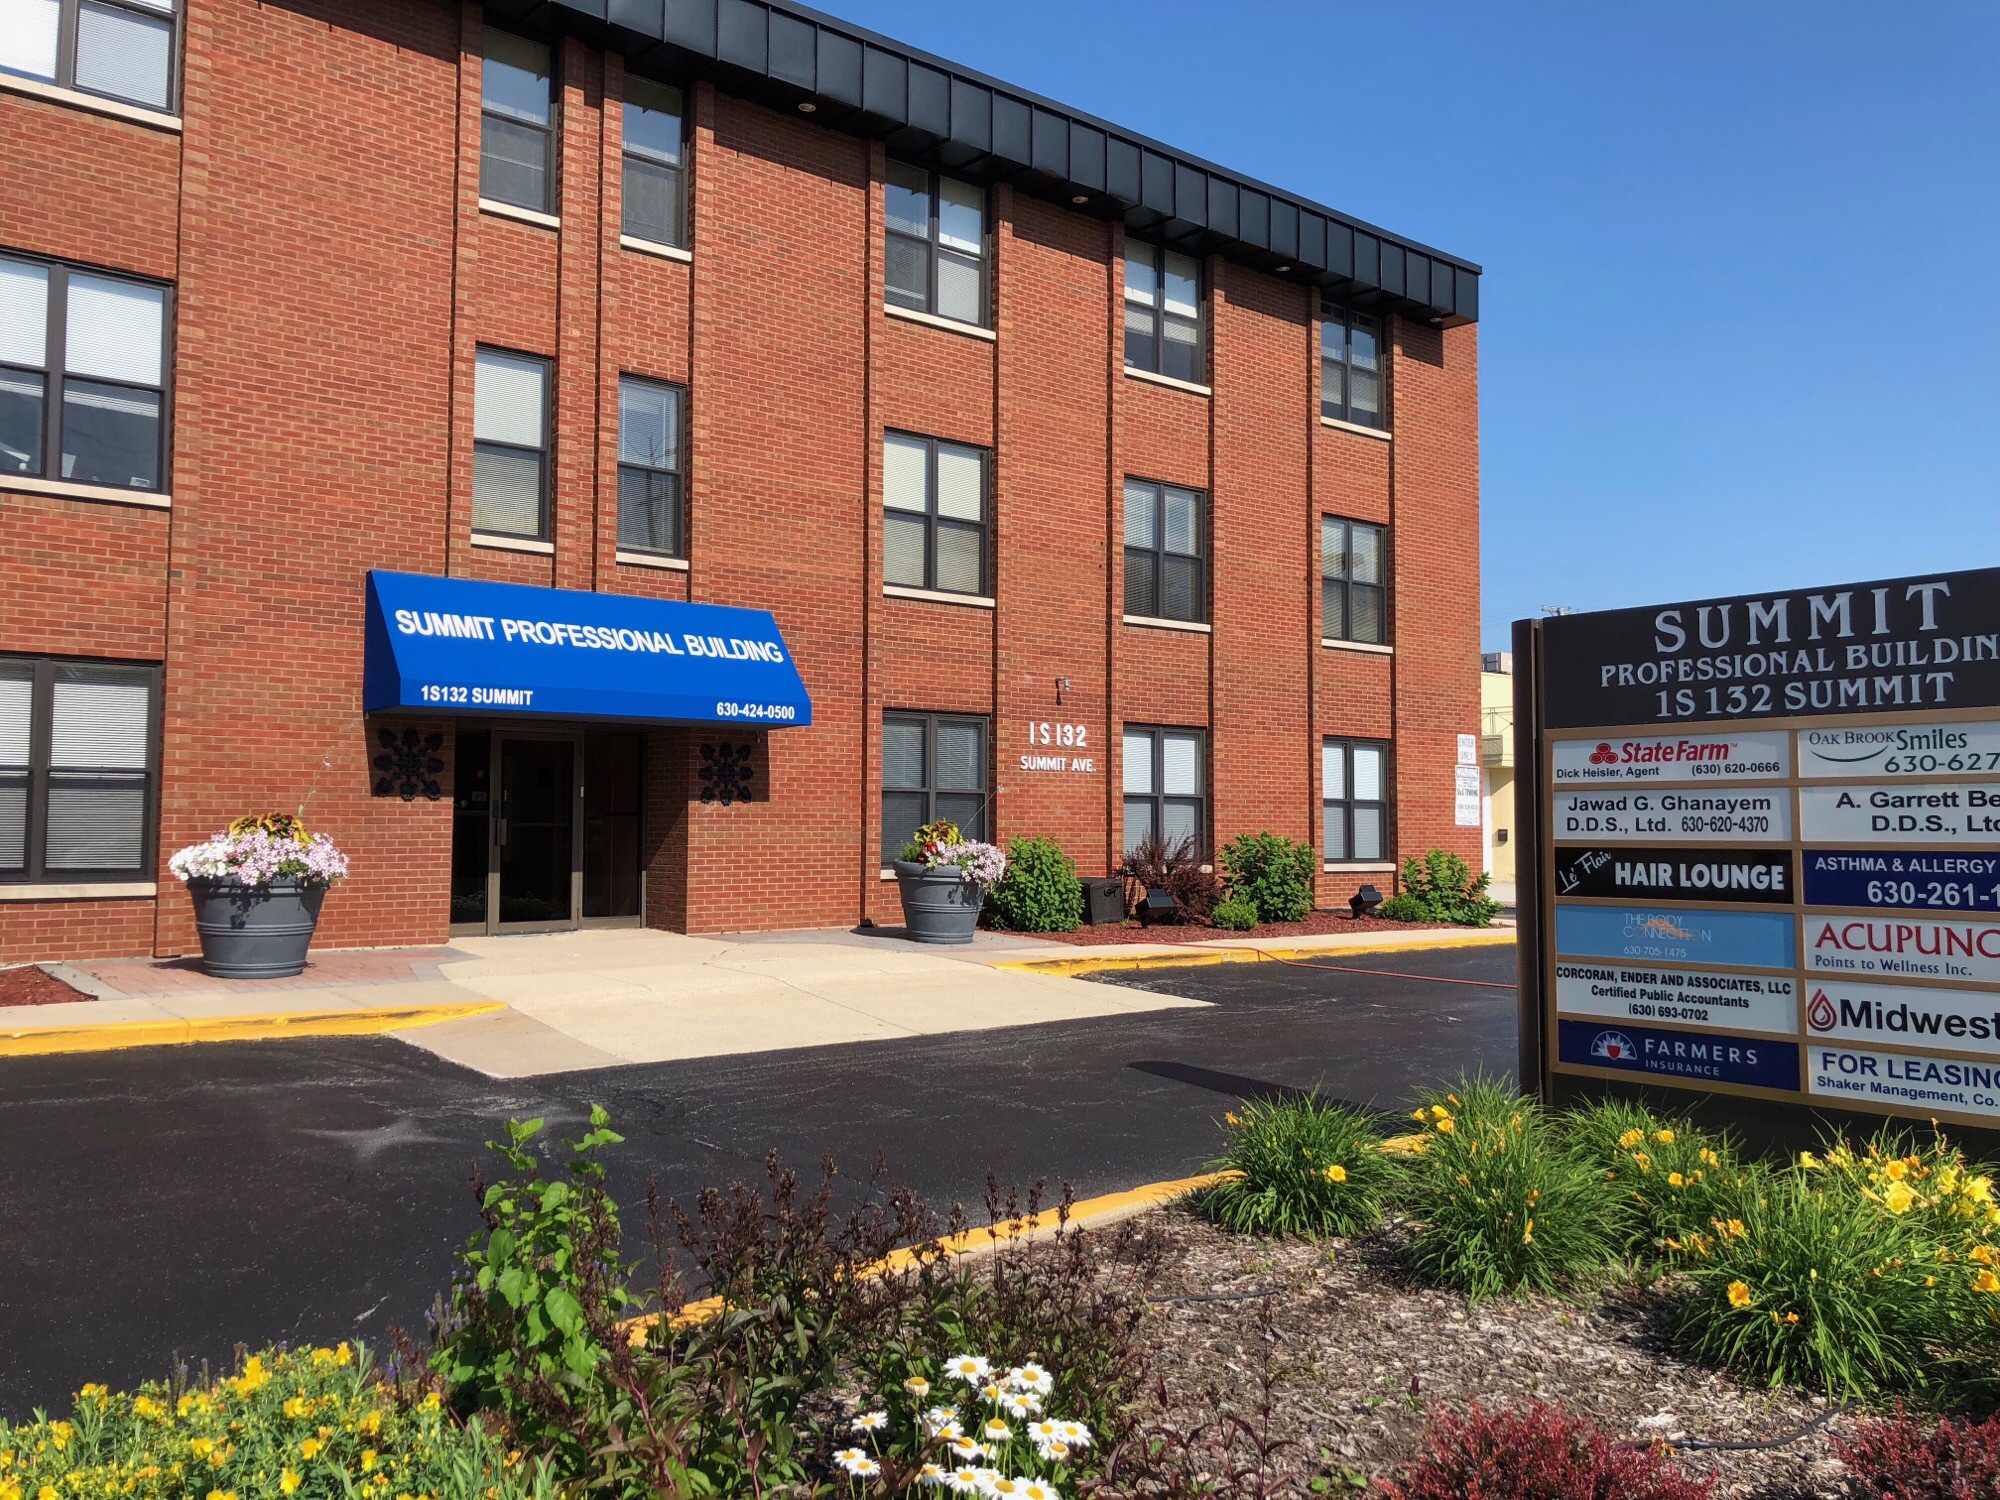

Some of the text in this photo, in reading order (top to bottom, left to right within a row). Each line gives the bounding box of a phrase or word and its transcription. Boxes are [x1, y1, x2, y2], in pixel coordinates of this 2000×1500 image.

[1655, 581, 1951, 653] SUMMIT
[395, 609, 784, 663] SUMMIT PROFESSIONAL BUILDING
[1601, 634, 2000, 687] PROFESSIONAL BUILDIN
[421, 685, 534, 706] 1S132 SUMMIT
[1784, 672, 1954, 710] SUMMIT
[716, 702, 795, 720] 630-424-0500
[1809, 728, 1967, 751] OAK BROOK Smiles
[1020, 755, 1097, 773] SUMMIT AVE.
[1556, 766, 1660, 778] Dick Heisler, Agent
[1691, 762, 1780, 776] (630) 620-0666
[1568, 796, 1771, 814] Jawad G. Ghanayem
[1836, 792, 1861, 808] A.
[1870, 791, 1960, 809] Garrett
[1567, 816, 1769, 834] D.D.S., Ltd. 630-620-4370
[1872, 815, 1957, 835] D.D.S.,
[1574, 851, 1611, 874] Flair
[1815, 857, 1997, 874] ASTHMA & ALLERGY
[1615, 862, 1785, 890] HAIR LOUNGE
[1623, 913, 1683, 927] THE BODY
[1815, 922, 2000, 959] ACUPUNC
[1623, 945, 1687, 958] 630-705-1475
[1815, 955, 1972, 976] Points to Wellness Inc.
[1556, 966, 1792, 995] CORCORAN, ENDER AND ASSOCIATES, LLC
[1591, 985, 1750, 1009] Certified Public Accountants
[1628, 1003, 1709, 1021] (630) 693-0702
[1644, 1038, 1758, 1065] FARMERS
[1645, 1059, 1721, 1077] INSURANCE
[1822, 1052, 1878, 1077] FOR
[1817, 1076, 1999, 1107] Shaker Management, Co.
